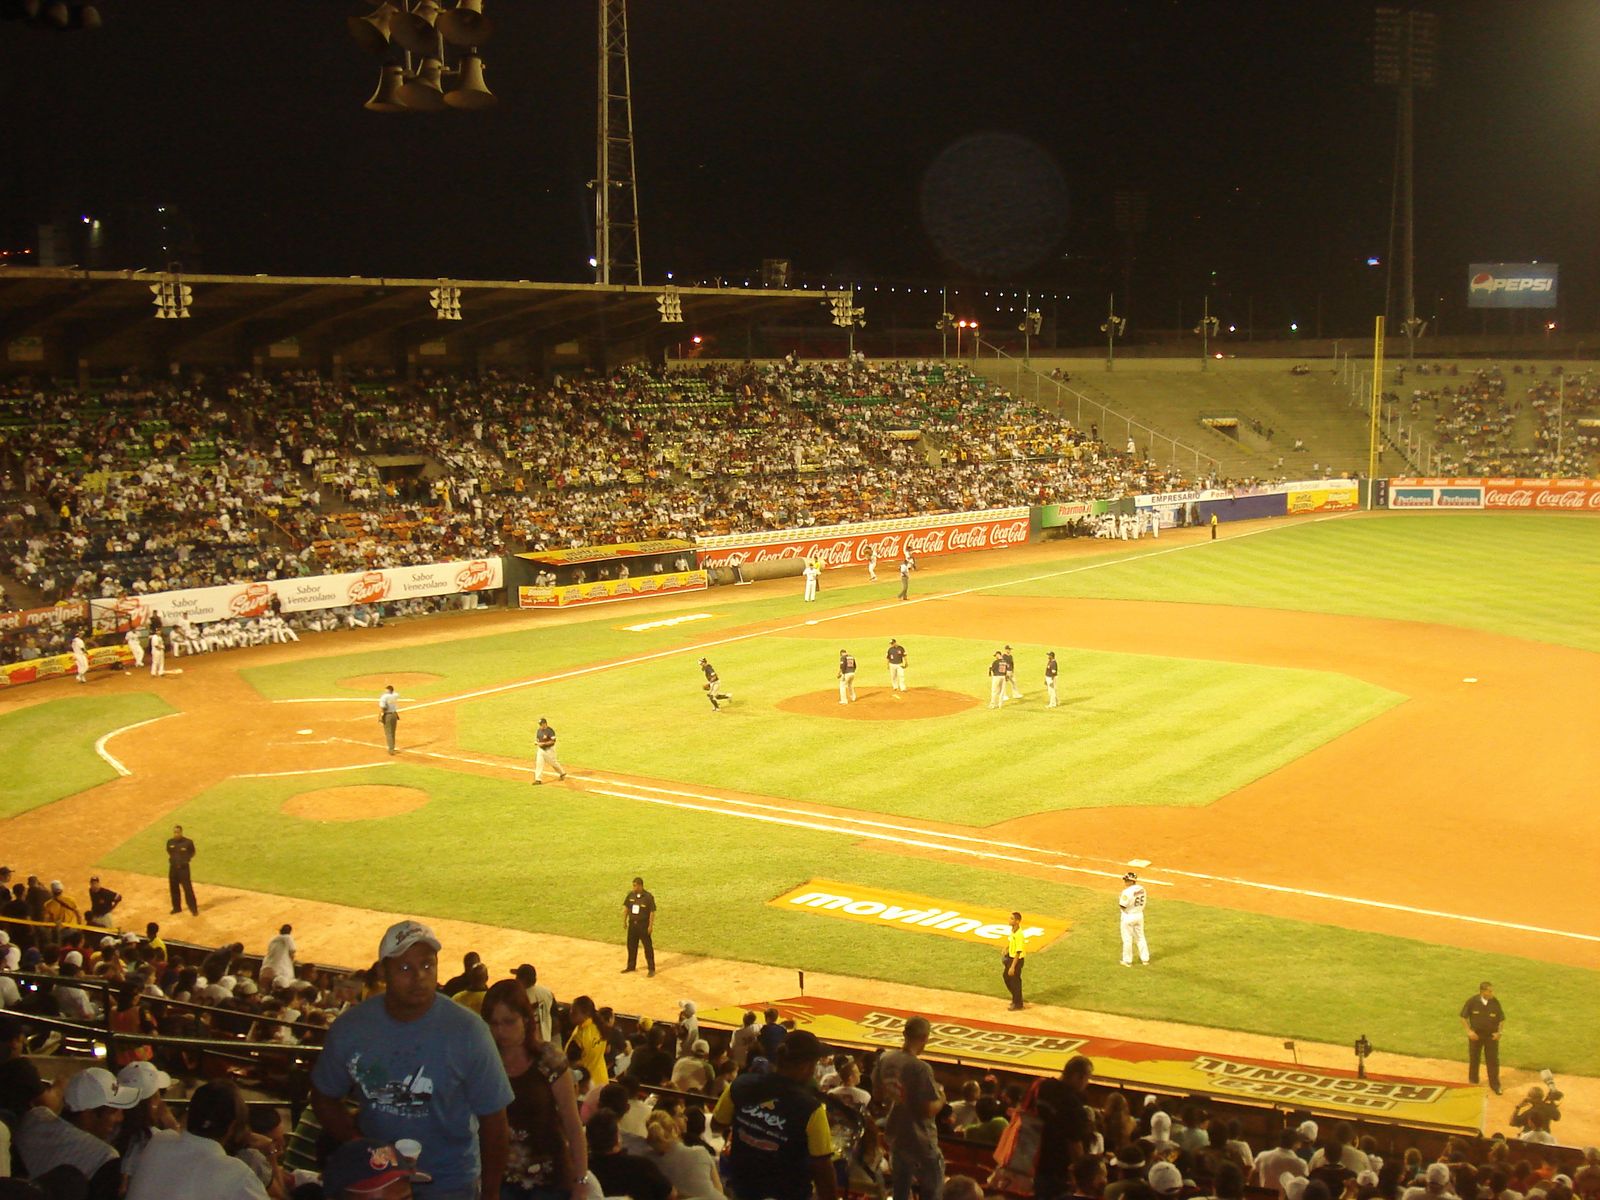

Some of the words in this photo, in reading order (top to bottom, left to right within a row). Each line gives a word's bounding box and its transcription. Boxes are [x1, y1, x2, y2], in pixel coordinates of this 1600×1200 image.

[1493, 278, 1553, 292] PEPSI
[1151, 490, 1201, 504] EMPRESARIO
[411, 572, 434, 582] Sabor
[296, 584, 321, 594] Sabor
[403, 579, 448, 592] Venezolano
[171, 598, 198, 608] Sabor
[287, 591, 336, 604] Venezolano
[865, 1014, 1081, 1050] REGIOAL
[1202, 1057, 1436, 1100] REGIONAL
[1218, 1080, 1392, 1108] malta
